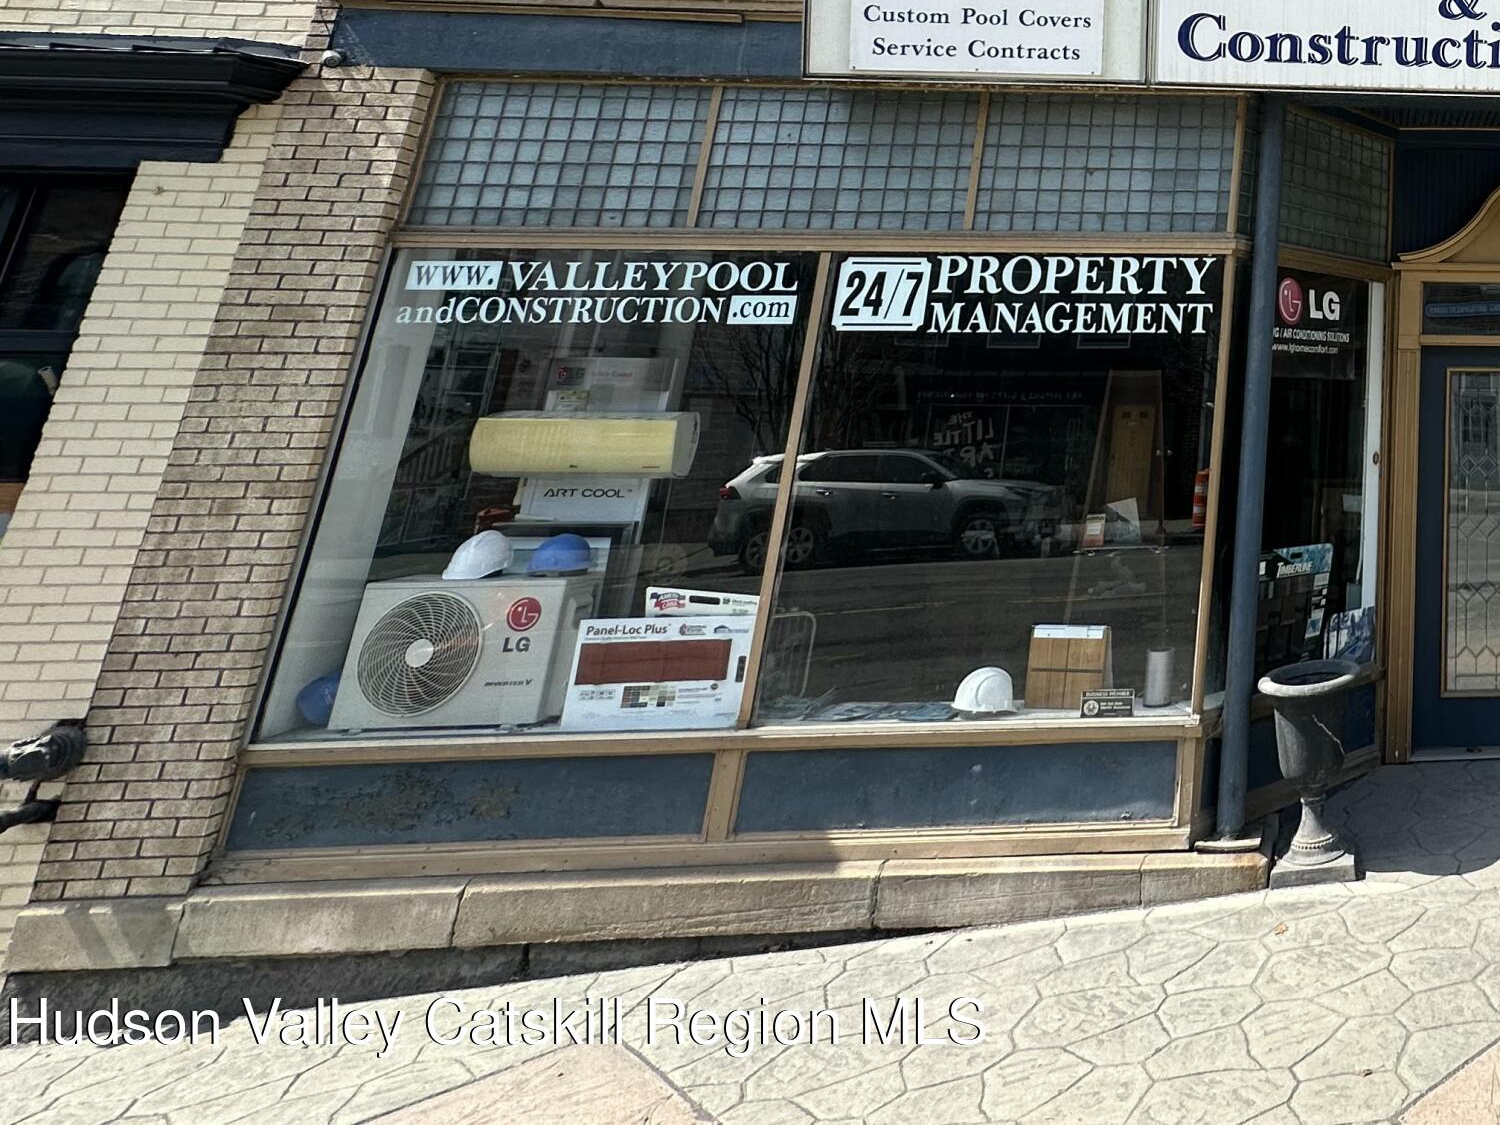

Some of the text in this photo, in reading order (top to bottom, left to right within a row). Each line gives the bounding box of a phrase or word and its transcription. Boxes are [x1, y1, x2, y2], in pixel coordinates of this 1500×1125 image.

[864, 5, 1091, 28] Custom Pool Covers
[872, 37, 1080, 60] Service Contracts
[508, 261, 797, 291] VALLEYPOOL
[932, 256, 1216, 295] PROPERTY
[840, 269, 924, 318] 24/7
[1308, 289, 1341, 321] LG
[396, 296, 790, 325] andCONSTRUCTION .com
[928, 302, 1212, 333] MANAGEMENT
[543, 488, 625, 498] ART COOL
[586, 622, 668, 636] Panel-Loc Plus
[502, 636, 531, 653] LG
